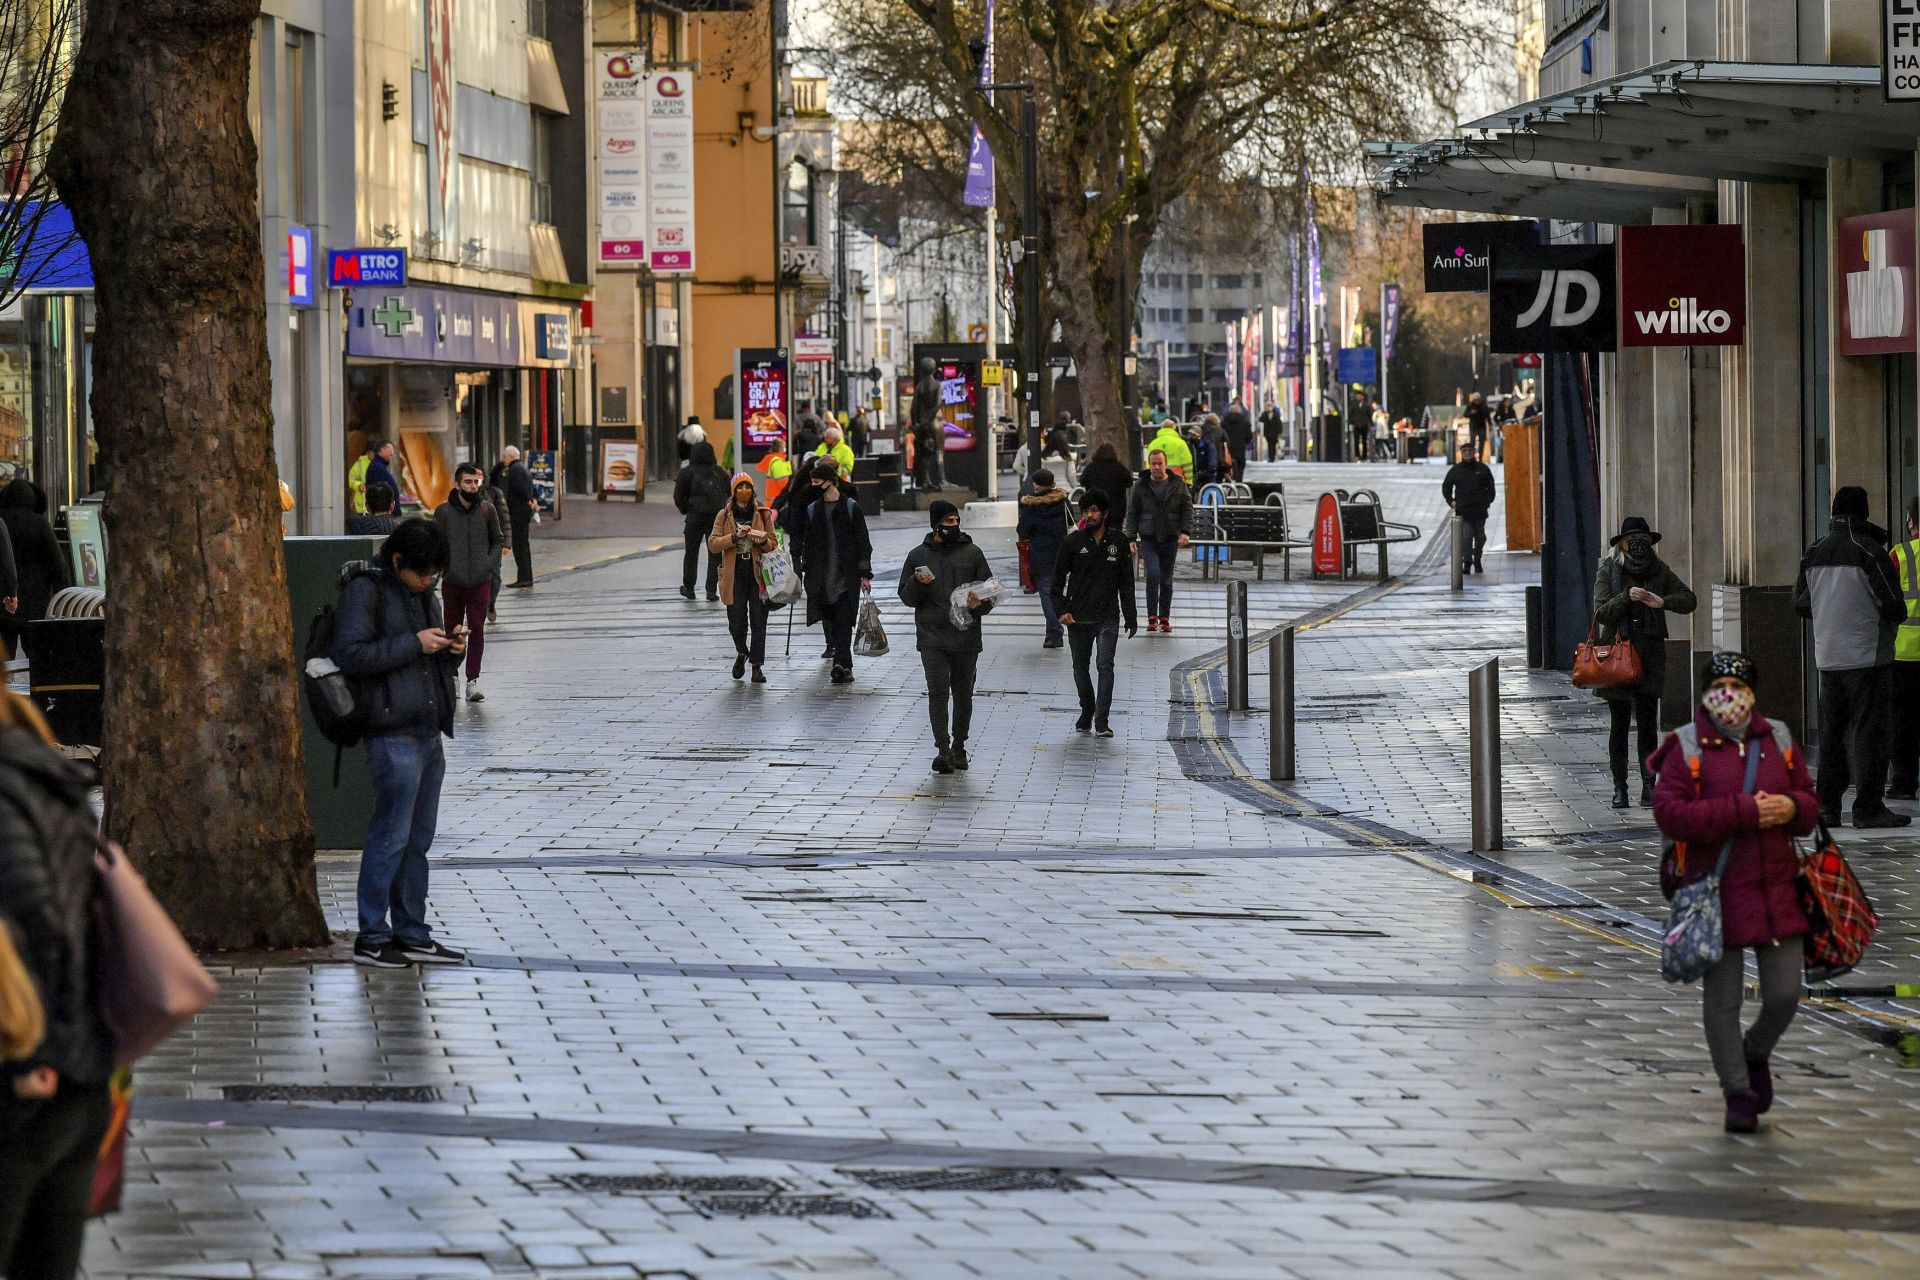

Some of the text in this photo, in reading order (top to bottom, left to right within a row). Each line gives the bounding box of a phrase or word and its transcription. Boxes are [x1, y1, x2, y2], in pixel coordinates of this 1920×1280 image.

[1893, 0, 1920, 15] L
[603, 89, 636, 97] ARCADE
[652, 100, 685, 108] QUEENS
[607, 138, 636, 149] Argos
[334, 255, 399, 280] METRO
[1434, 255, 1461, 269] Ann
[362, 270, 399, 280] BANK
[1516, 269, 1601, 329] JD
[1634, 297, 1731, 334] wilko
[748, 388, 780, 399] GRAVY
